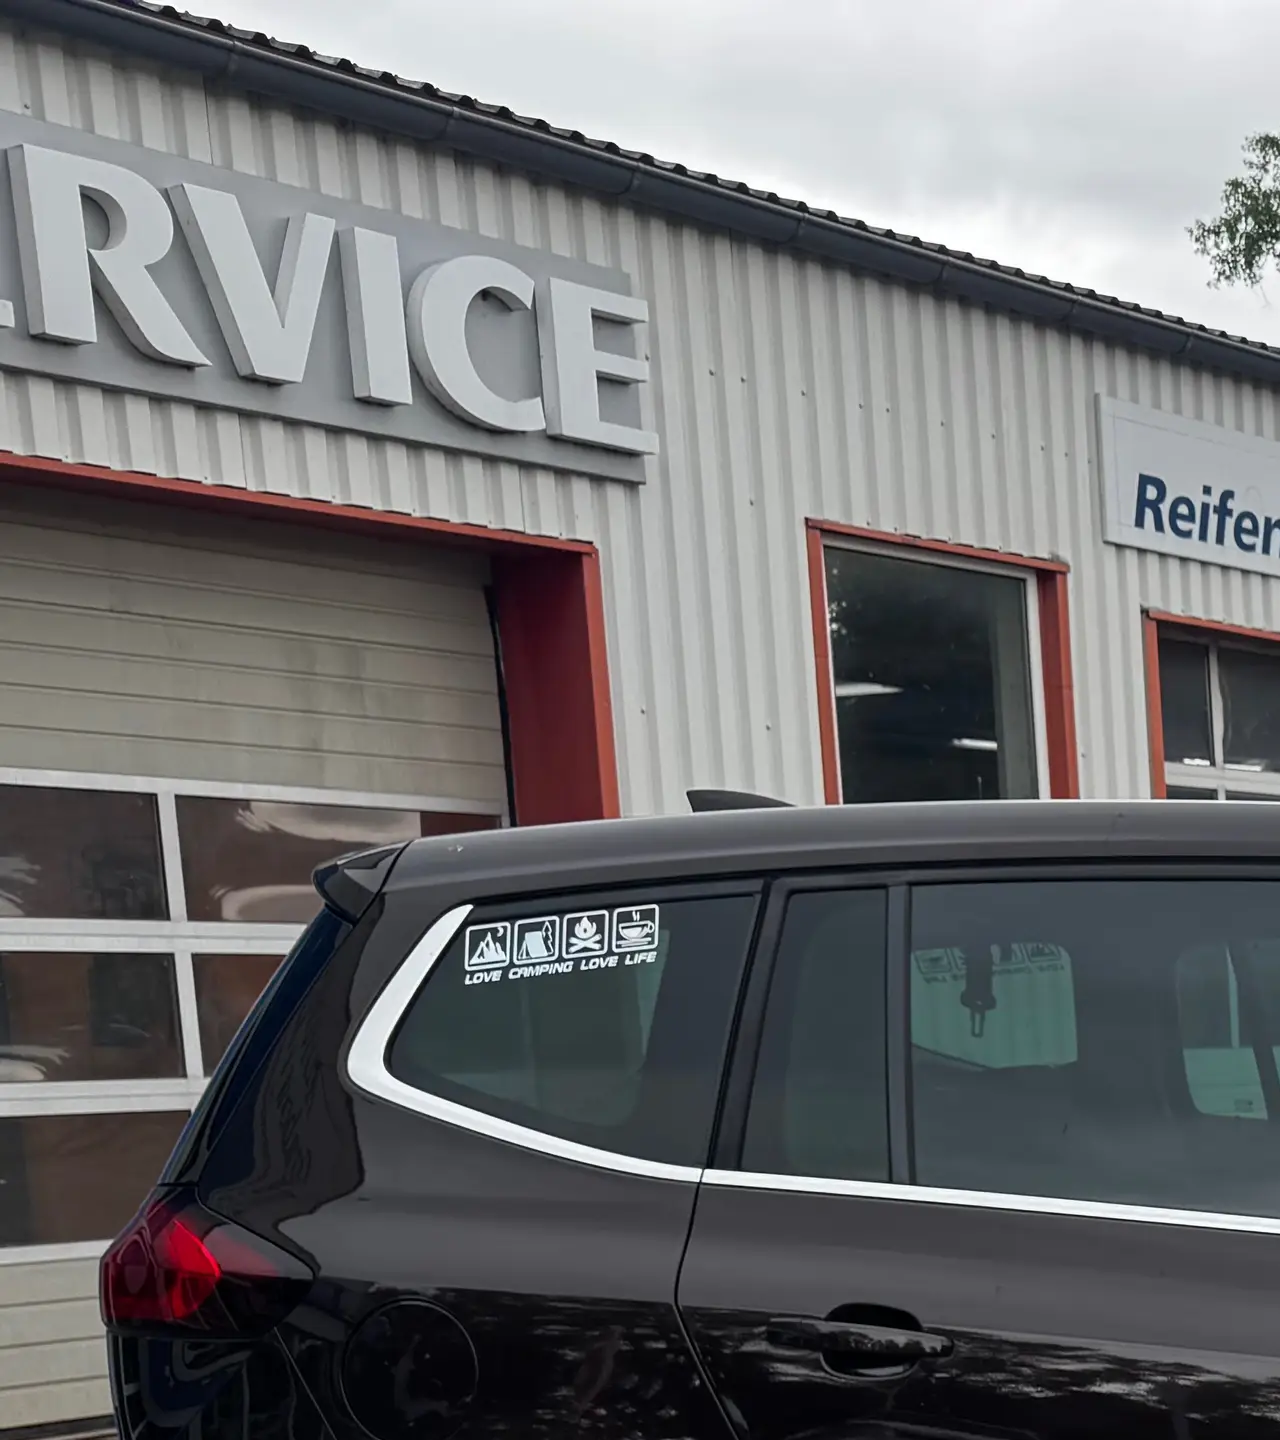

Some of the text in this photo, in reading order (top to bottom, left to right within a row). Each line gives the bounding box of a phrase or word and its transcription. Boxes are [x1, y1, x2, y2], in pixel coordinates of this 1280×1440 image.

[0, 143, 659, 456] RVICE
[464, 951, 657, 985] LOVE CAMPING LOVE LIFE
